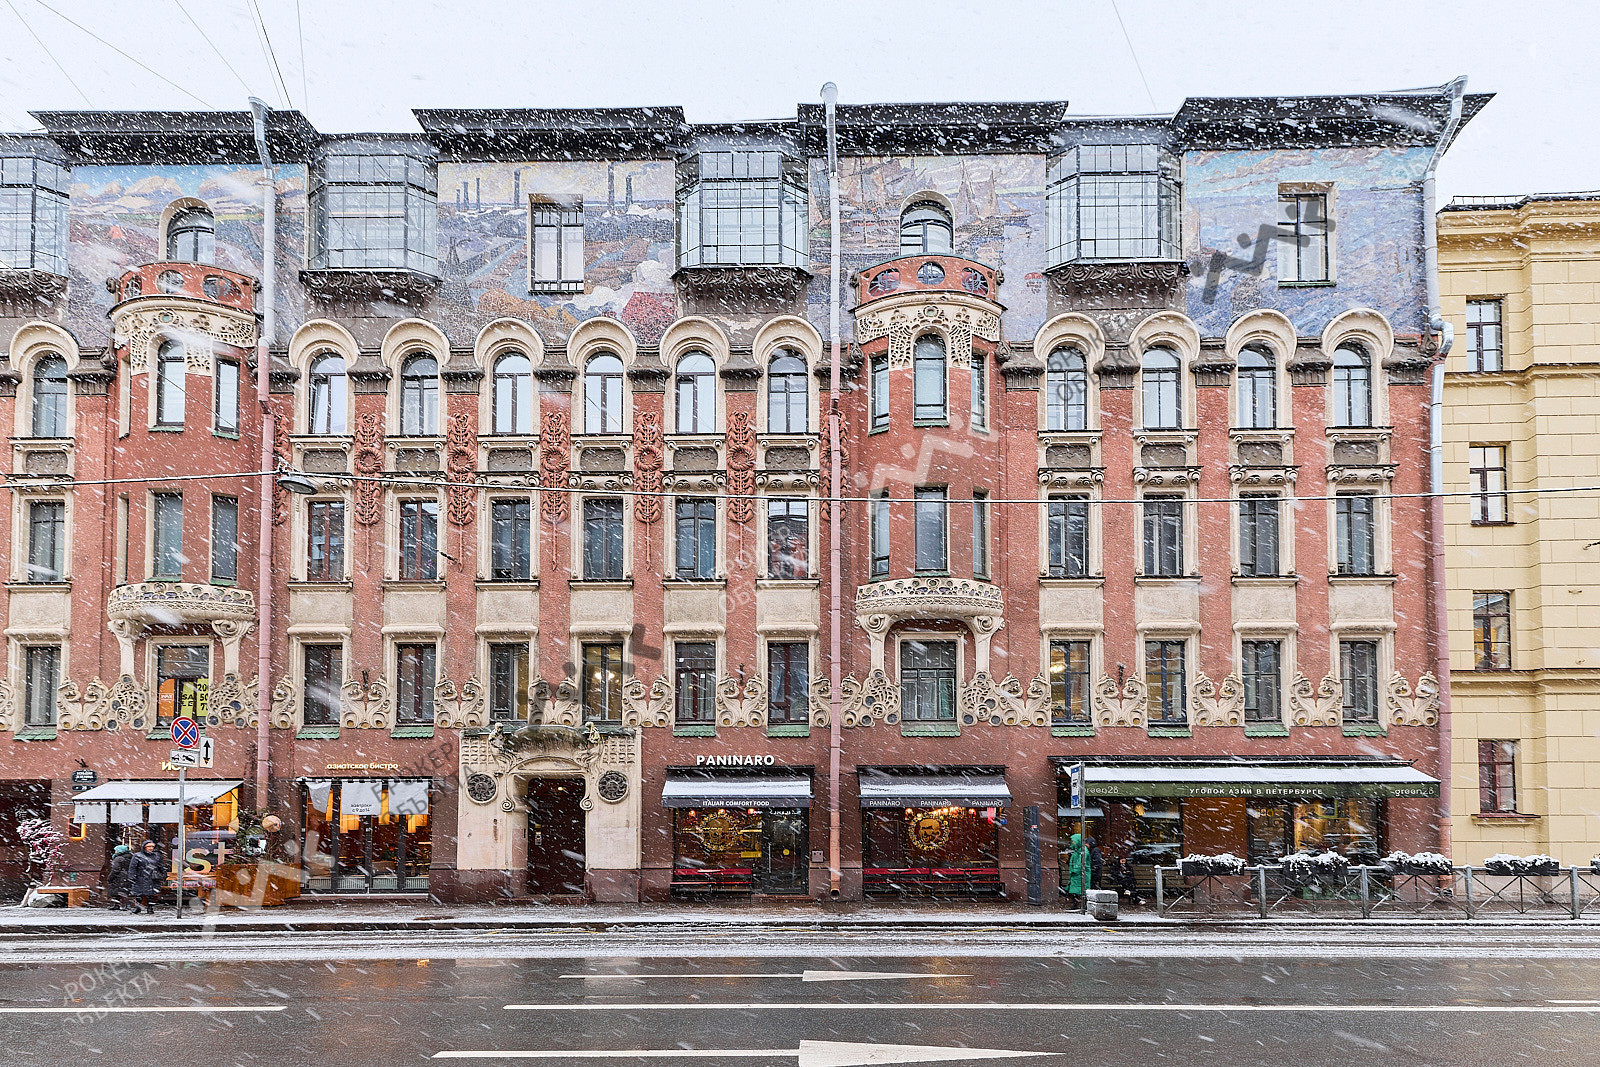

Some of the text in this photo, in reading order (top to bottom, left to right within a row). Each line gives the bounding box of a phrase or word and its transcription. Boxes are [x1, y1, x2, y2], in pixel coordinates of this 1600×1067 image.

[696, 755, 775, 766] PANINARO
[369, 762, 399, 771] бистро
[1084, 786, 1119, 795] reen28
[1394, 787, 1434, 796] green28
[171, 837, 234, 873] ist
